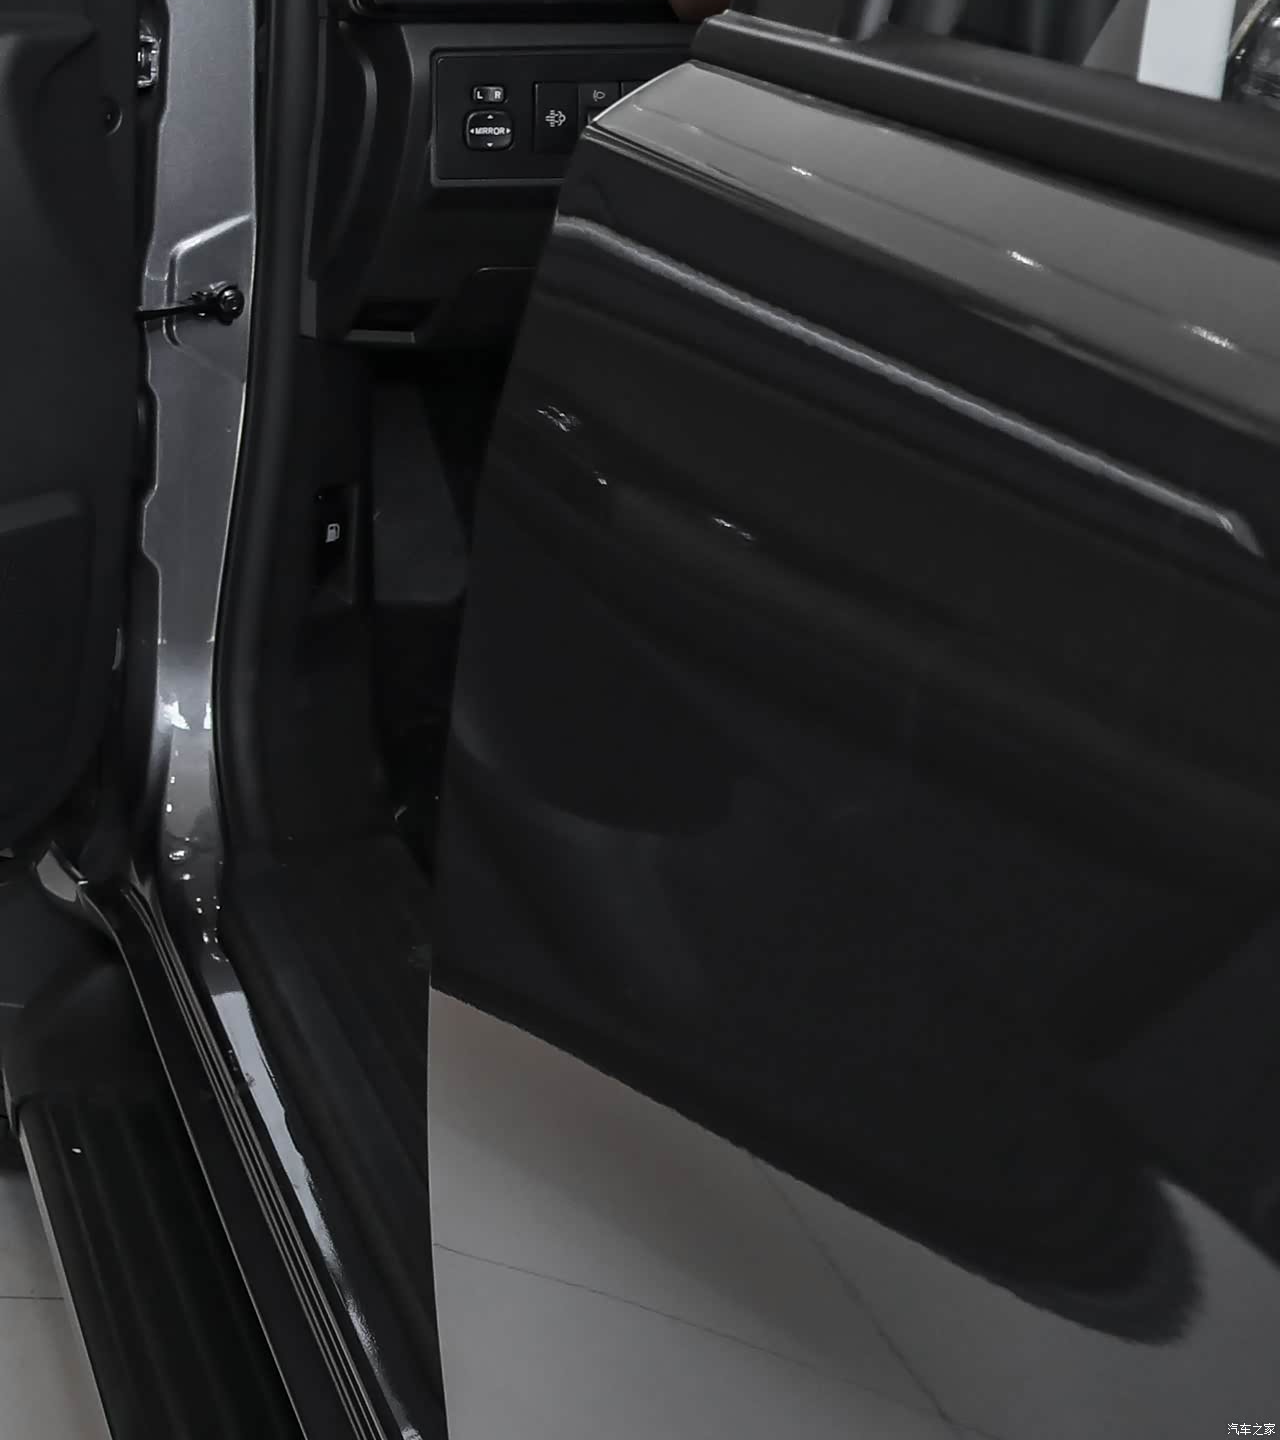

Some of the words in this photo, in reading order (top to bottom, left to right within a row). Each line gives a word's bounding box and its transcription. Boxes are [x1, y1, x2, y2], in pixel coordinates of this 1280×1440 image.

[476, 90, 484, 100] L
[494, 90, 502, 100] R
[475, 126, 506, 136] MIRROR
